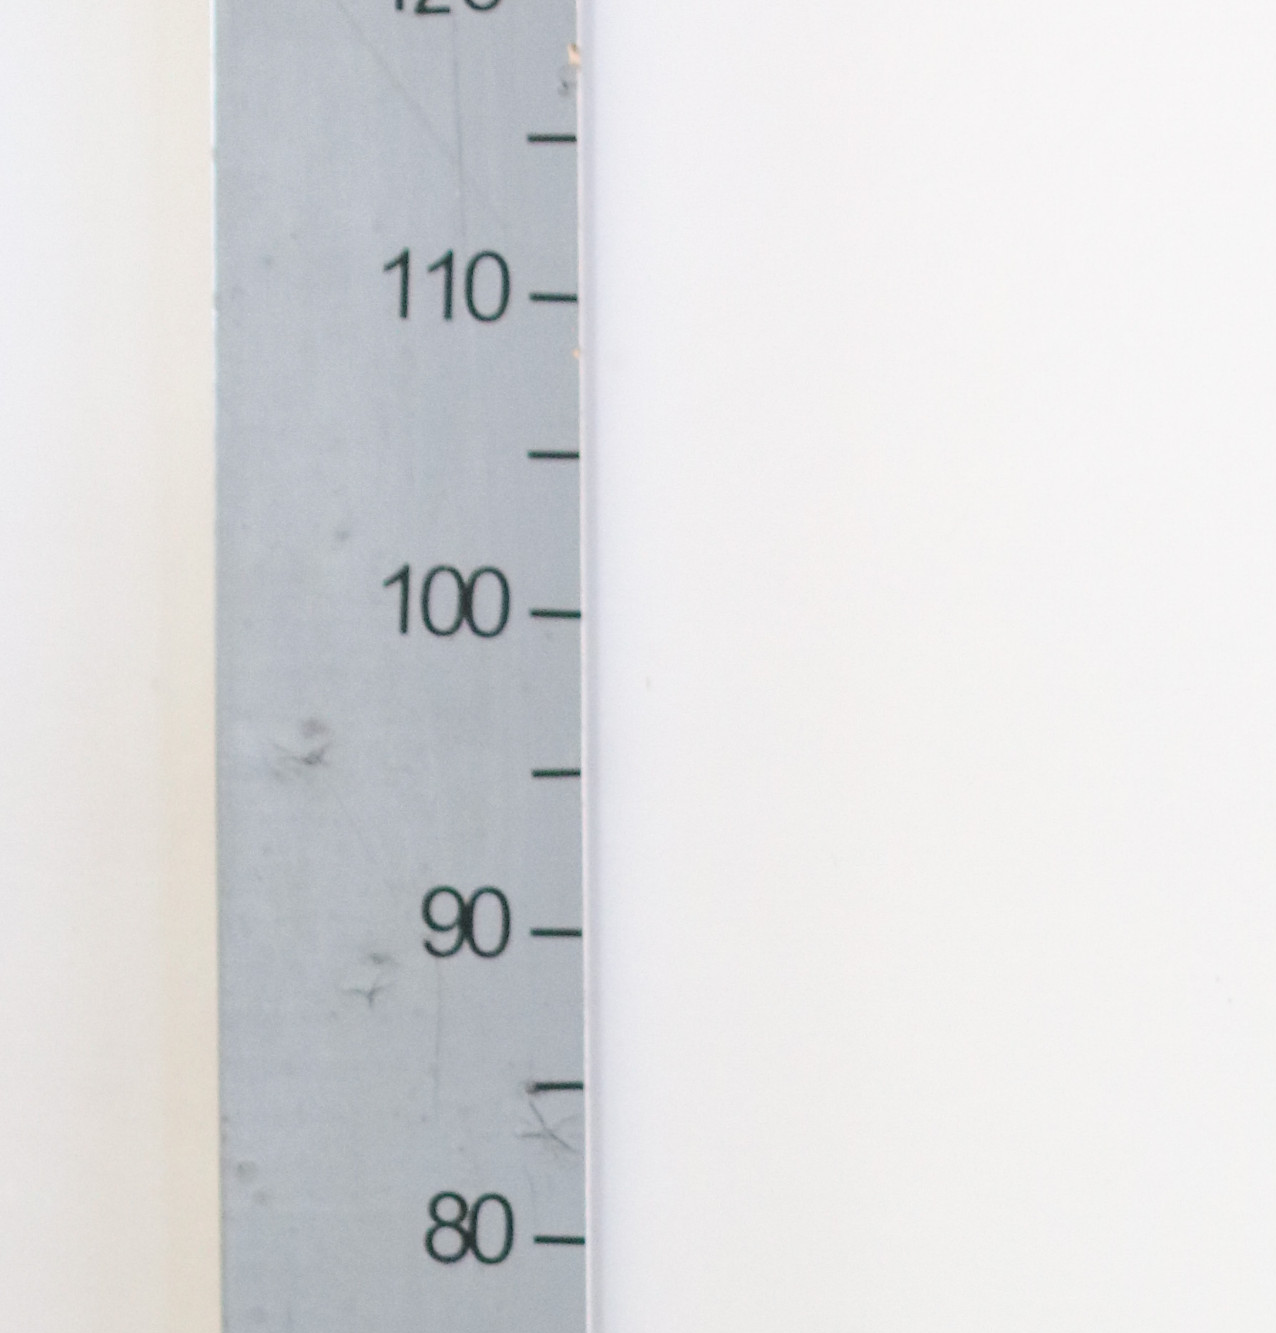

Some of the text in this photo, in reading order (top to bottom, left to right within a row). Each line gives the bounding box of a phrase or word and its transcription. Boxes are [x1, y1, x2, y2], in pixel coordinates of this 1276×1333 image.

[383, 249, 511, 323] 110
[383, 563, 511, 638] 100
[421, 885, 511, 959] 90
[425, 1191, 514, 1264] 80
